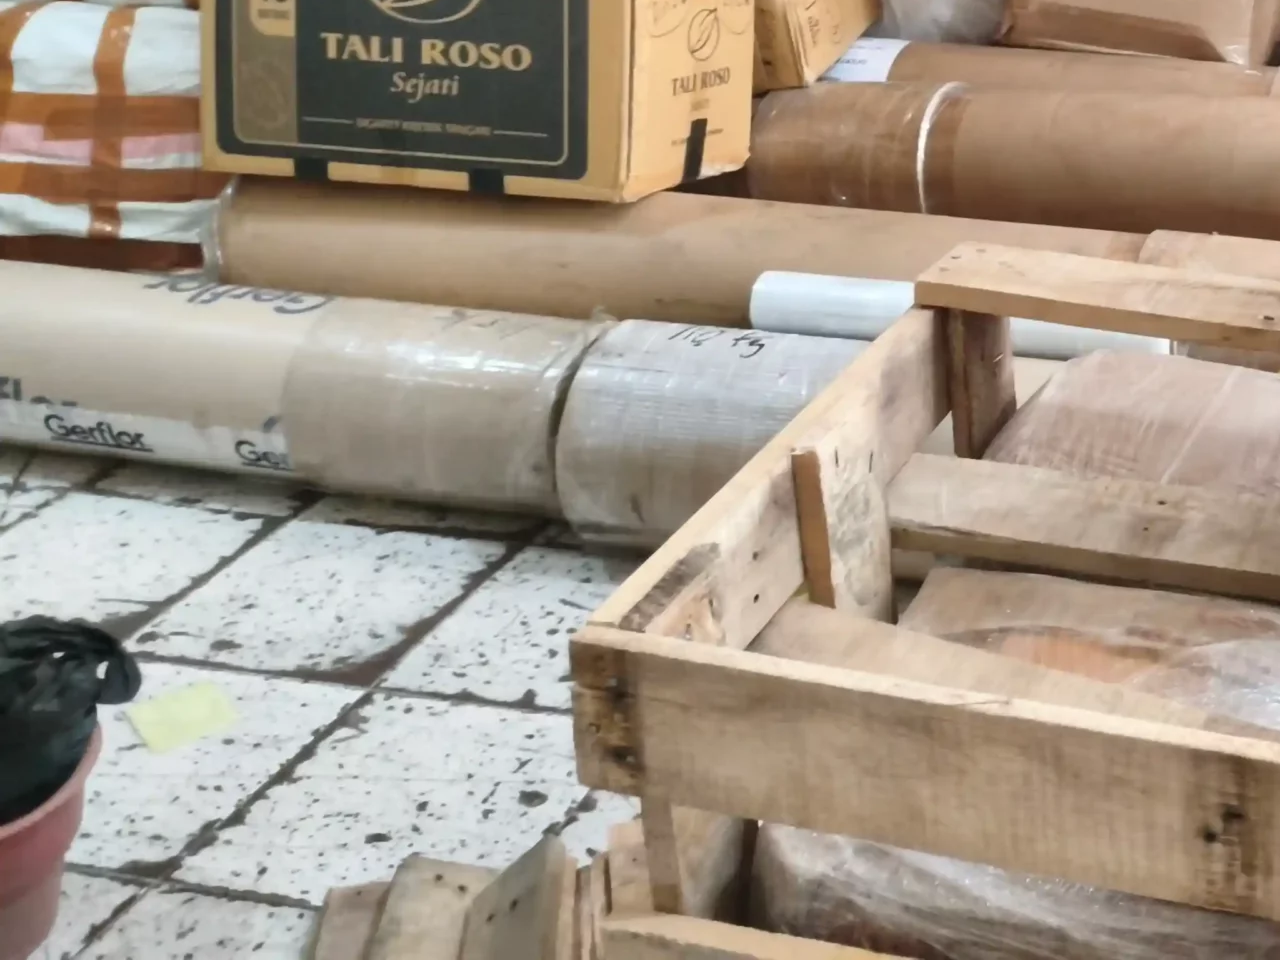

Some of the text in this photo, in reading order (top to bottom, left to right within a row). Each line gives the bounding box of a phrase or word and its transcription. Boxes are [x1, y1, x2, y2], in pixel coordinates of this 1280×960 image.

[320, 32, 533, 72] TALI ROSO
[390, 71, 460, 104] Sejati
[44, 413, 146, 449] Gerflor
